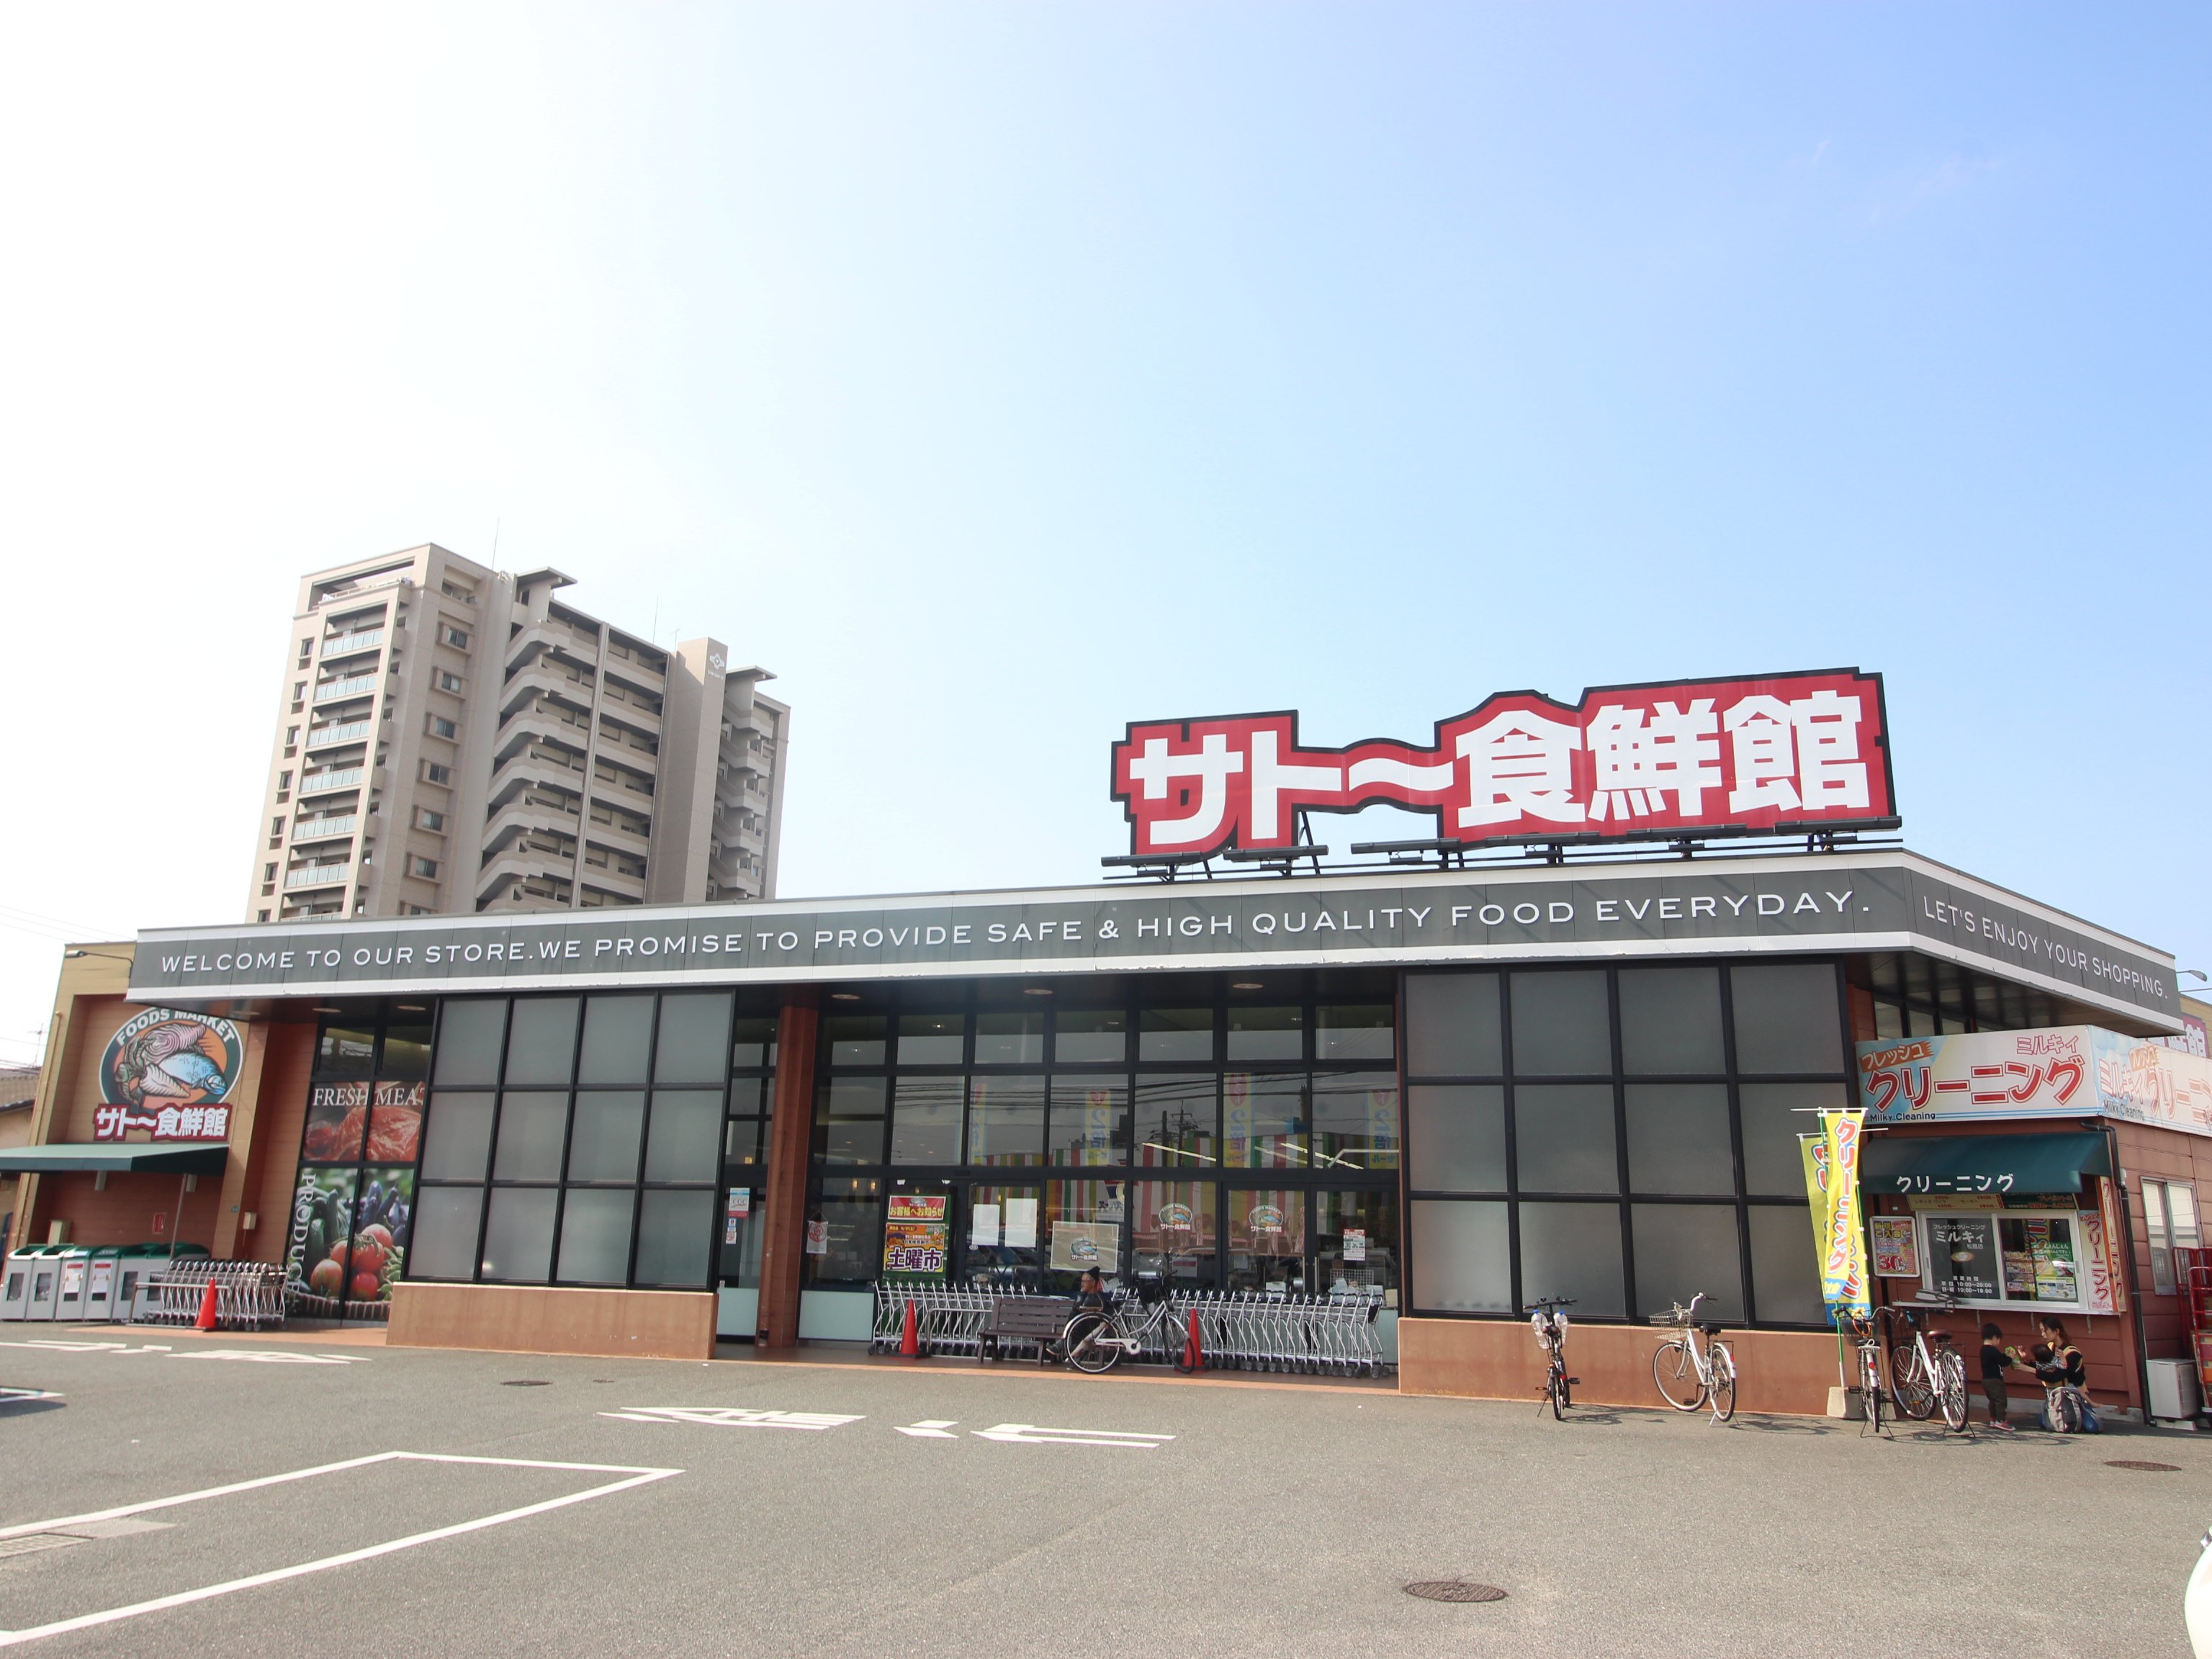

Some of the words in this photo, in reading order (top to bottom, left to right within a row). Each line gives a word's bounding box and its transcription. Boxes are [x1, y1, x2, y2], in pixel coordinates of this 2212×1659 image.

[161, 951, 295, 973] WELCOME
[307, 949, 342, 968] TO
[354, 946, 413, 966] OUR
[595, 934, 742, 957] PROMISE
[756, 931, 798, 950] TO
[814, 925, 972, 949] PROVIDE
[987, 920, 1082, 943] SAFE
[1099, 920, 1120, 939] &
[1138, 915, 1233, 938] HIGH
[1252, 907, 1432, 935] QUALITY
[1451, 902, 1575, 926] FOOD
[1596, 890, 1870, 922] EVERYDAY.
[1923, 896, 1976, 932] LET'S
[1982, 917, 2038, 954] ENJOY
[2044, 938, 2088, 972] YOUR
[2092, 957, 2168, 999] SHOPPING.
[116, 1009, 170, 1046] FOODS
[174, 1010, 235, 1043] MARKET
[1861, 1043, 1925, 1070] フレッシュ
[1865, 1054, 2085, 1112] クリーニング
[313, 1087, 369, 1107] FRESH
[2103, 1100, 2120, 1115] Milky
[2120, 1104, 2144, 1121] Cleaning
[1870, 1113, 1892, 1122] Milky
[1895, 1112, 1936, 1120] Cleaning
[1827, 1118, 1858, 1274] クリーニング
[1896, 1173, 2014, 1193] クリーニング
[890, 1206, 943, 1217] お客様へお知らせ
[286, 1173, 316, 1293] PRODUCE
[888, 1247, 943, 1272] 土曜市
[1877, 1254, 1903, 1272] 30
[2086, 1219, 2110, 1300] クリーニング
